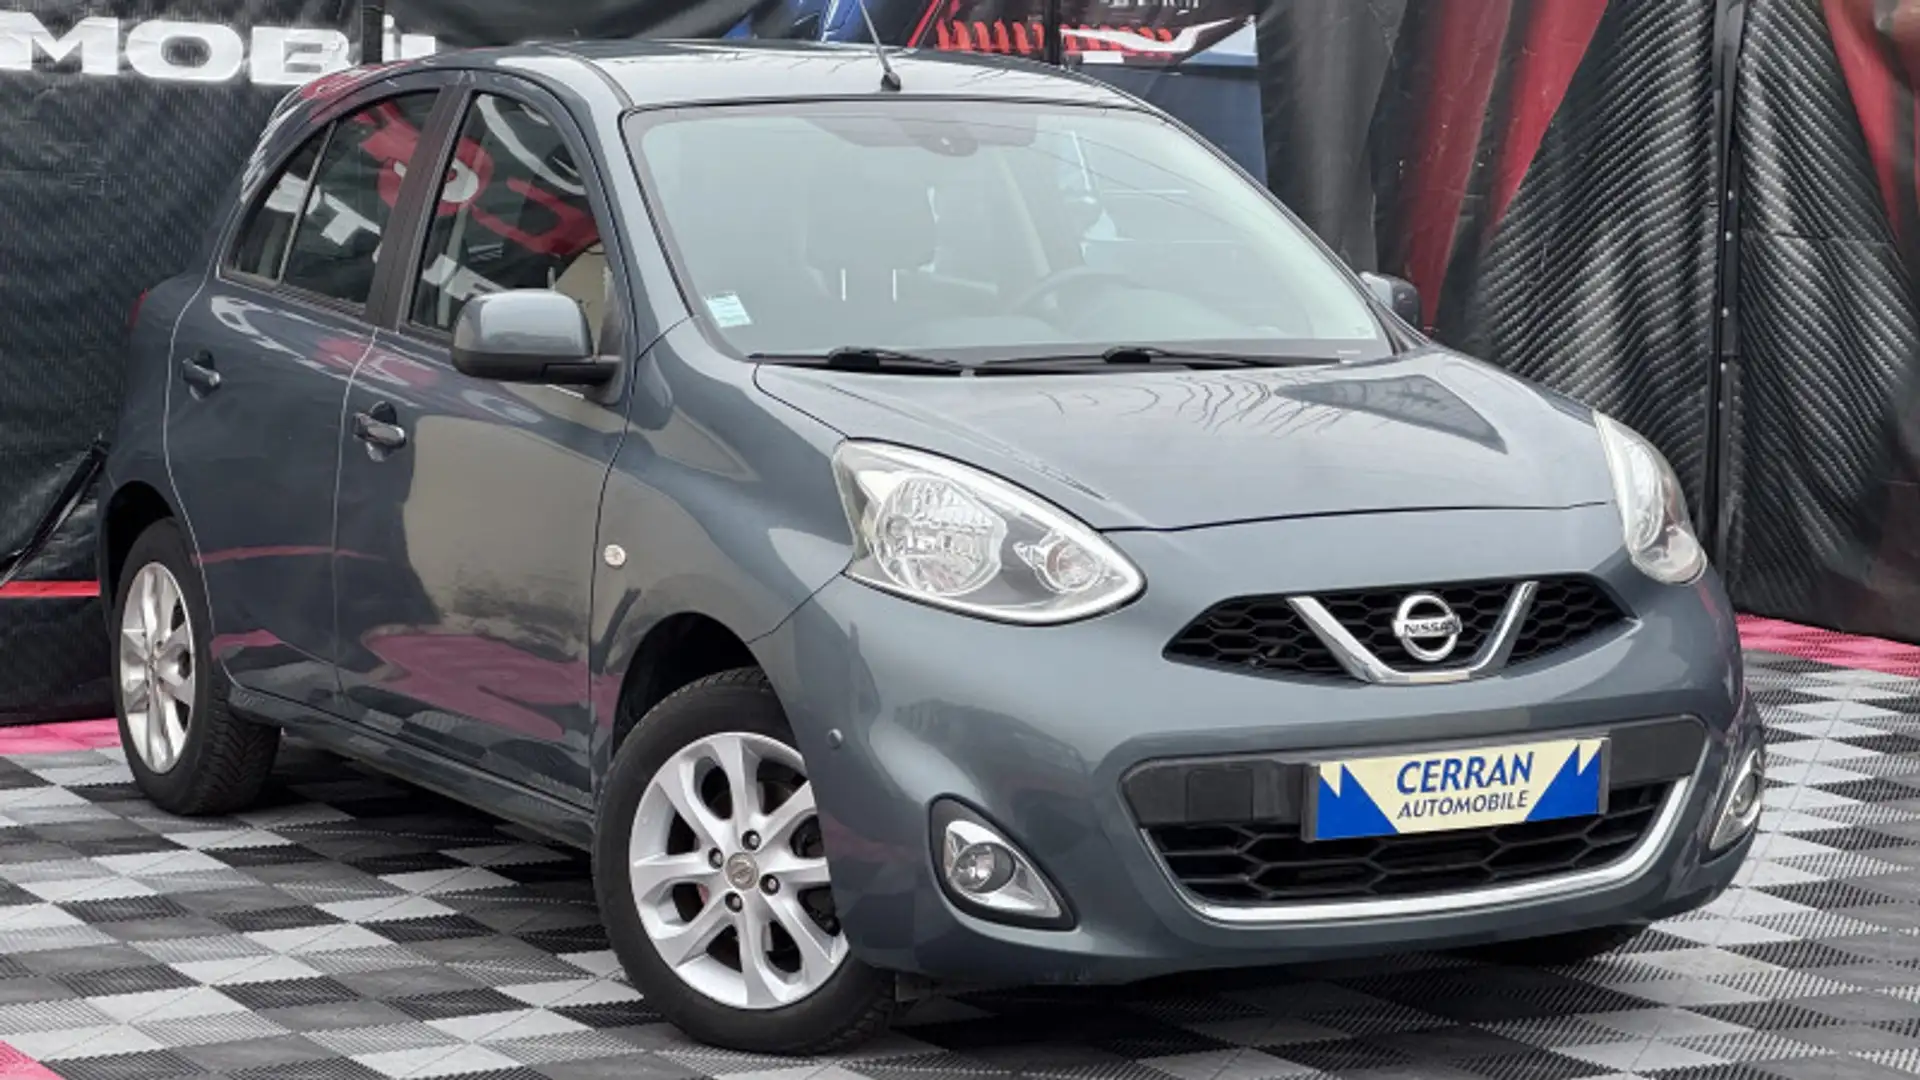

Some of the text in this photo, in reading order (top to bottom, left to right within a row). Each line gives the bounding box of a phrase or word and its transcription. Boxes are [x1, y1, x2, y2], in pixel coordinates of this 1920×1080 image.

[1403, 621, 1460, 635] NISSAN
[1396, 751, 1535, 795] CERRAN
[1396, 790, 1530, 820] AUTOMOBILE
